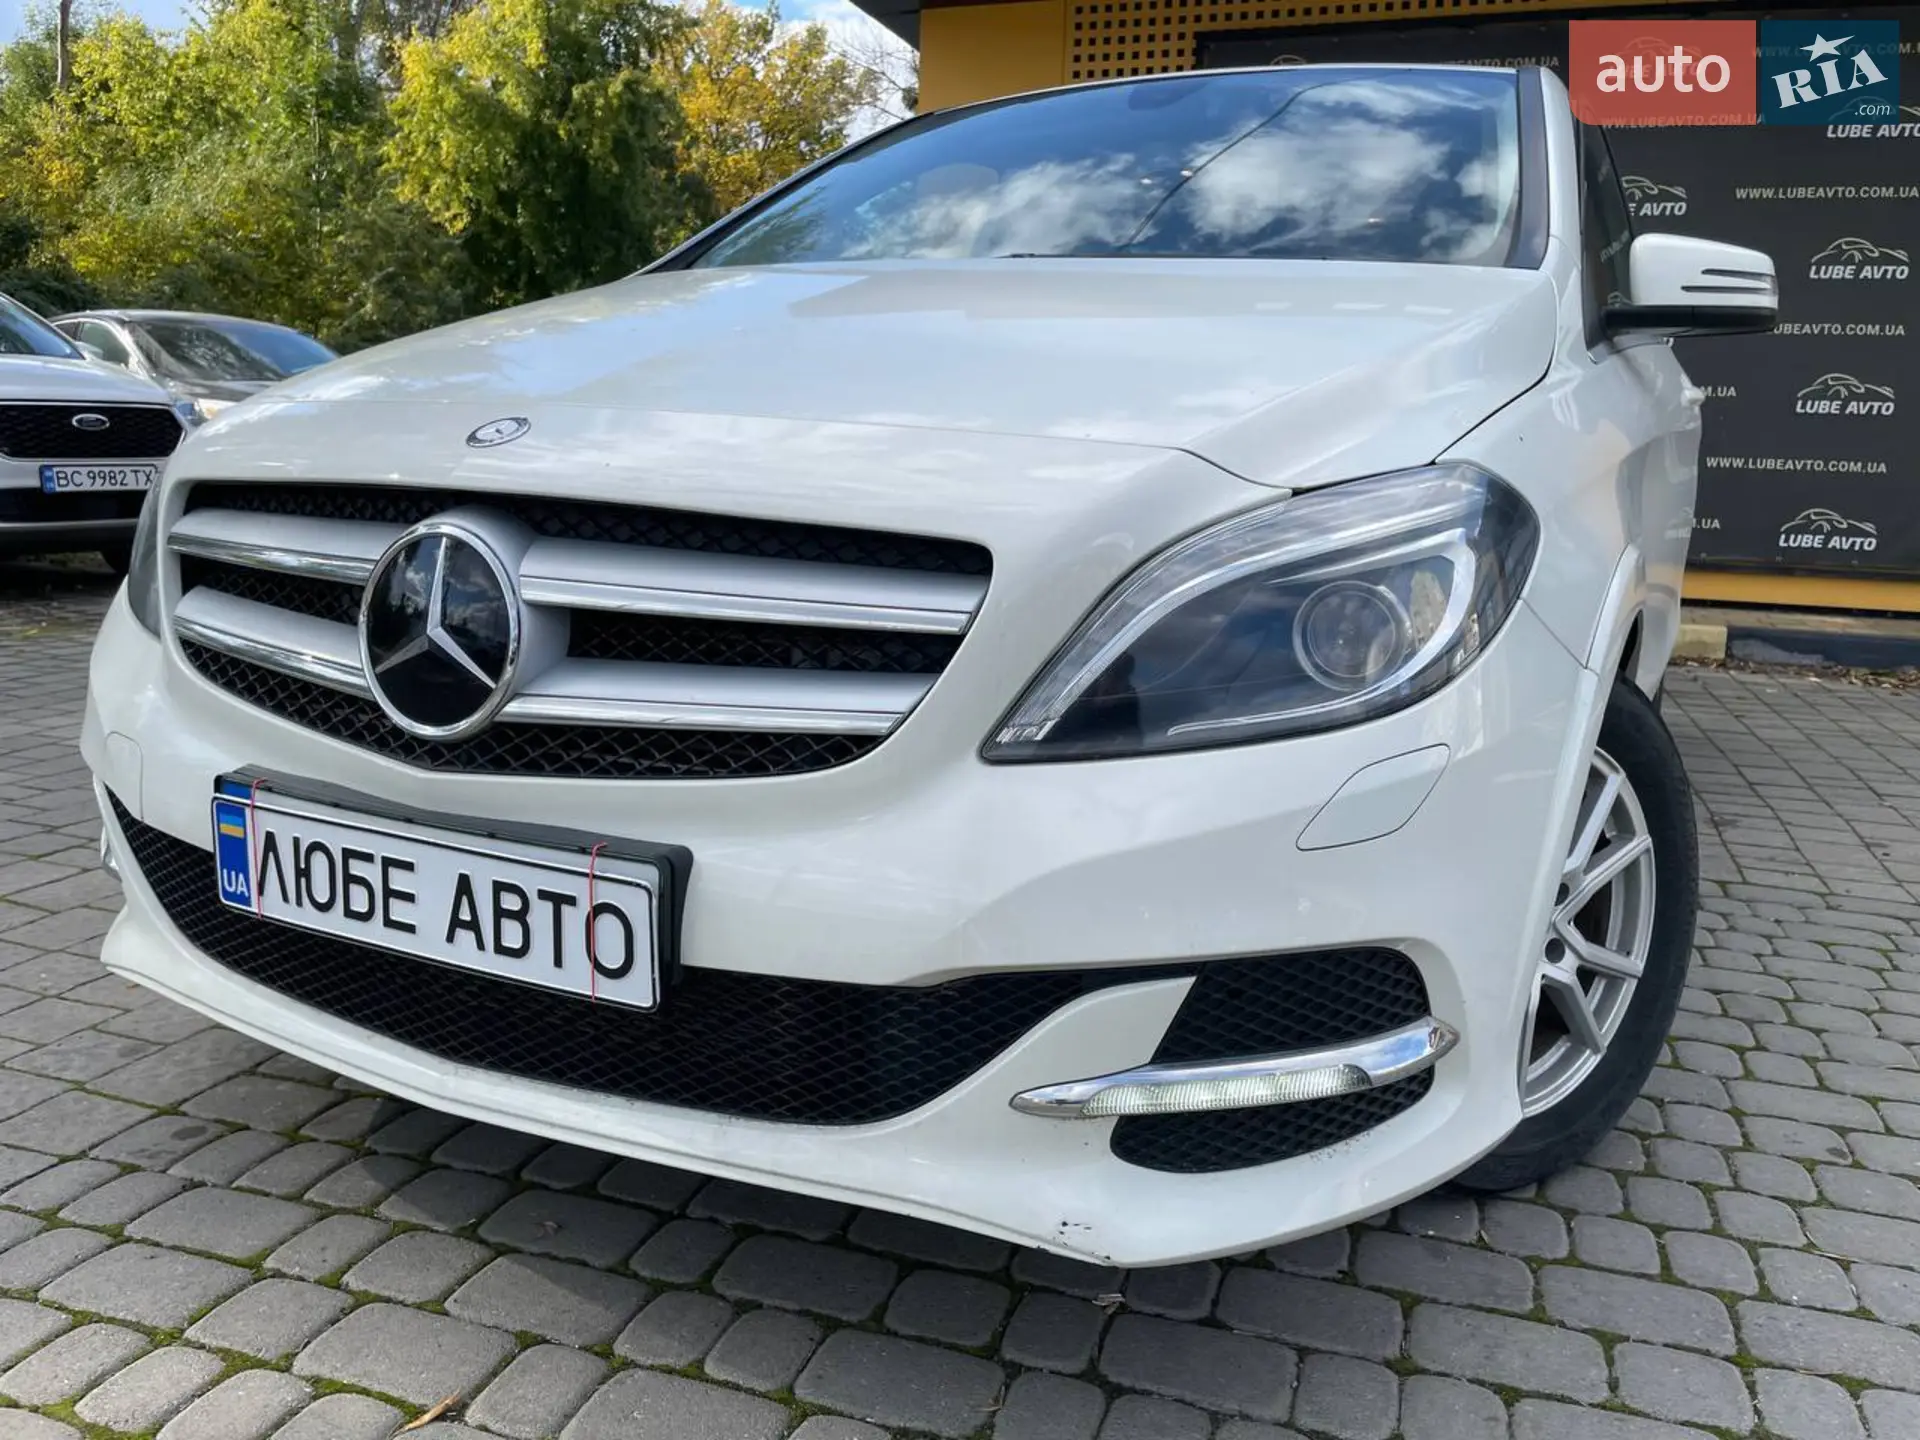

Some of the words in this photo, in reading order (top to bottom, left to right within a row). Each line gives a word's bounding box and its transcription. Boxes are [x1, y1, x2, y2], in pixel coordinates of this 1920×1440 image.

[1826, 124, 1873, 138] LUBE
[1735, 186, 1920, 199] WWW.LUBEAVTO.COM.UA
[1639, 202, 1688, 216] AVTO
[1809, 264, 1857, 280] LUBE
[1859, 265, 1910, 280] AVTO
[1795, 400, 1843, 415] LUBE
[1845, 400, 1895, 416] AVTO
[1706, 456, 1887, 474] WWW.LUBEAVTO.COM.UA
[56, 470, 84, 488] BC
[86, 469, 128, 488] 9982
[1778, 533, 1826, 549] LUBE
[1827, 533, 1878, 551] AVTO
[222, 868, 250, 897] UA
[258, 830, 416, 934] ЛЮБЕ
[445, 872, 635, 980] АВТО
